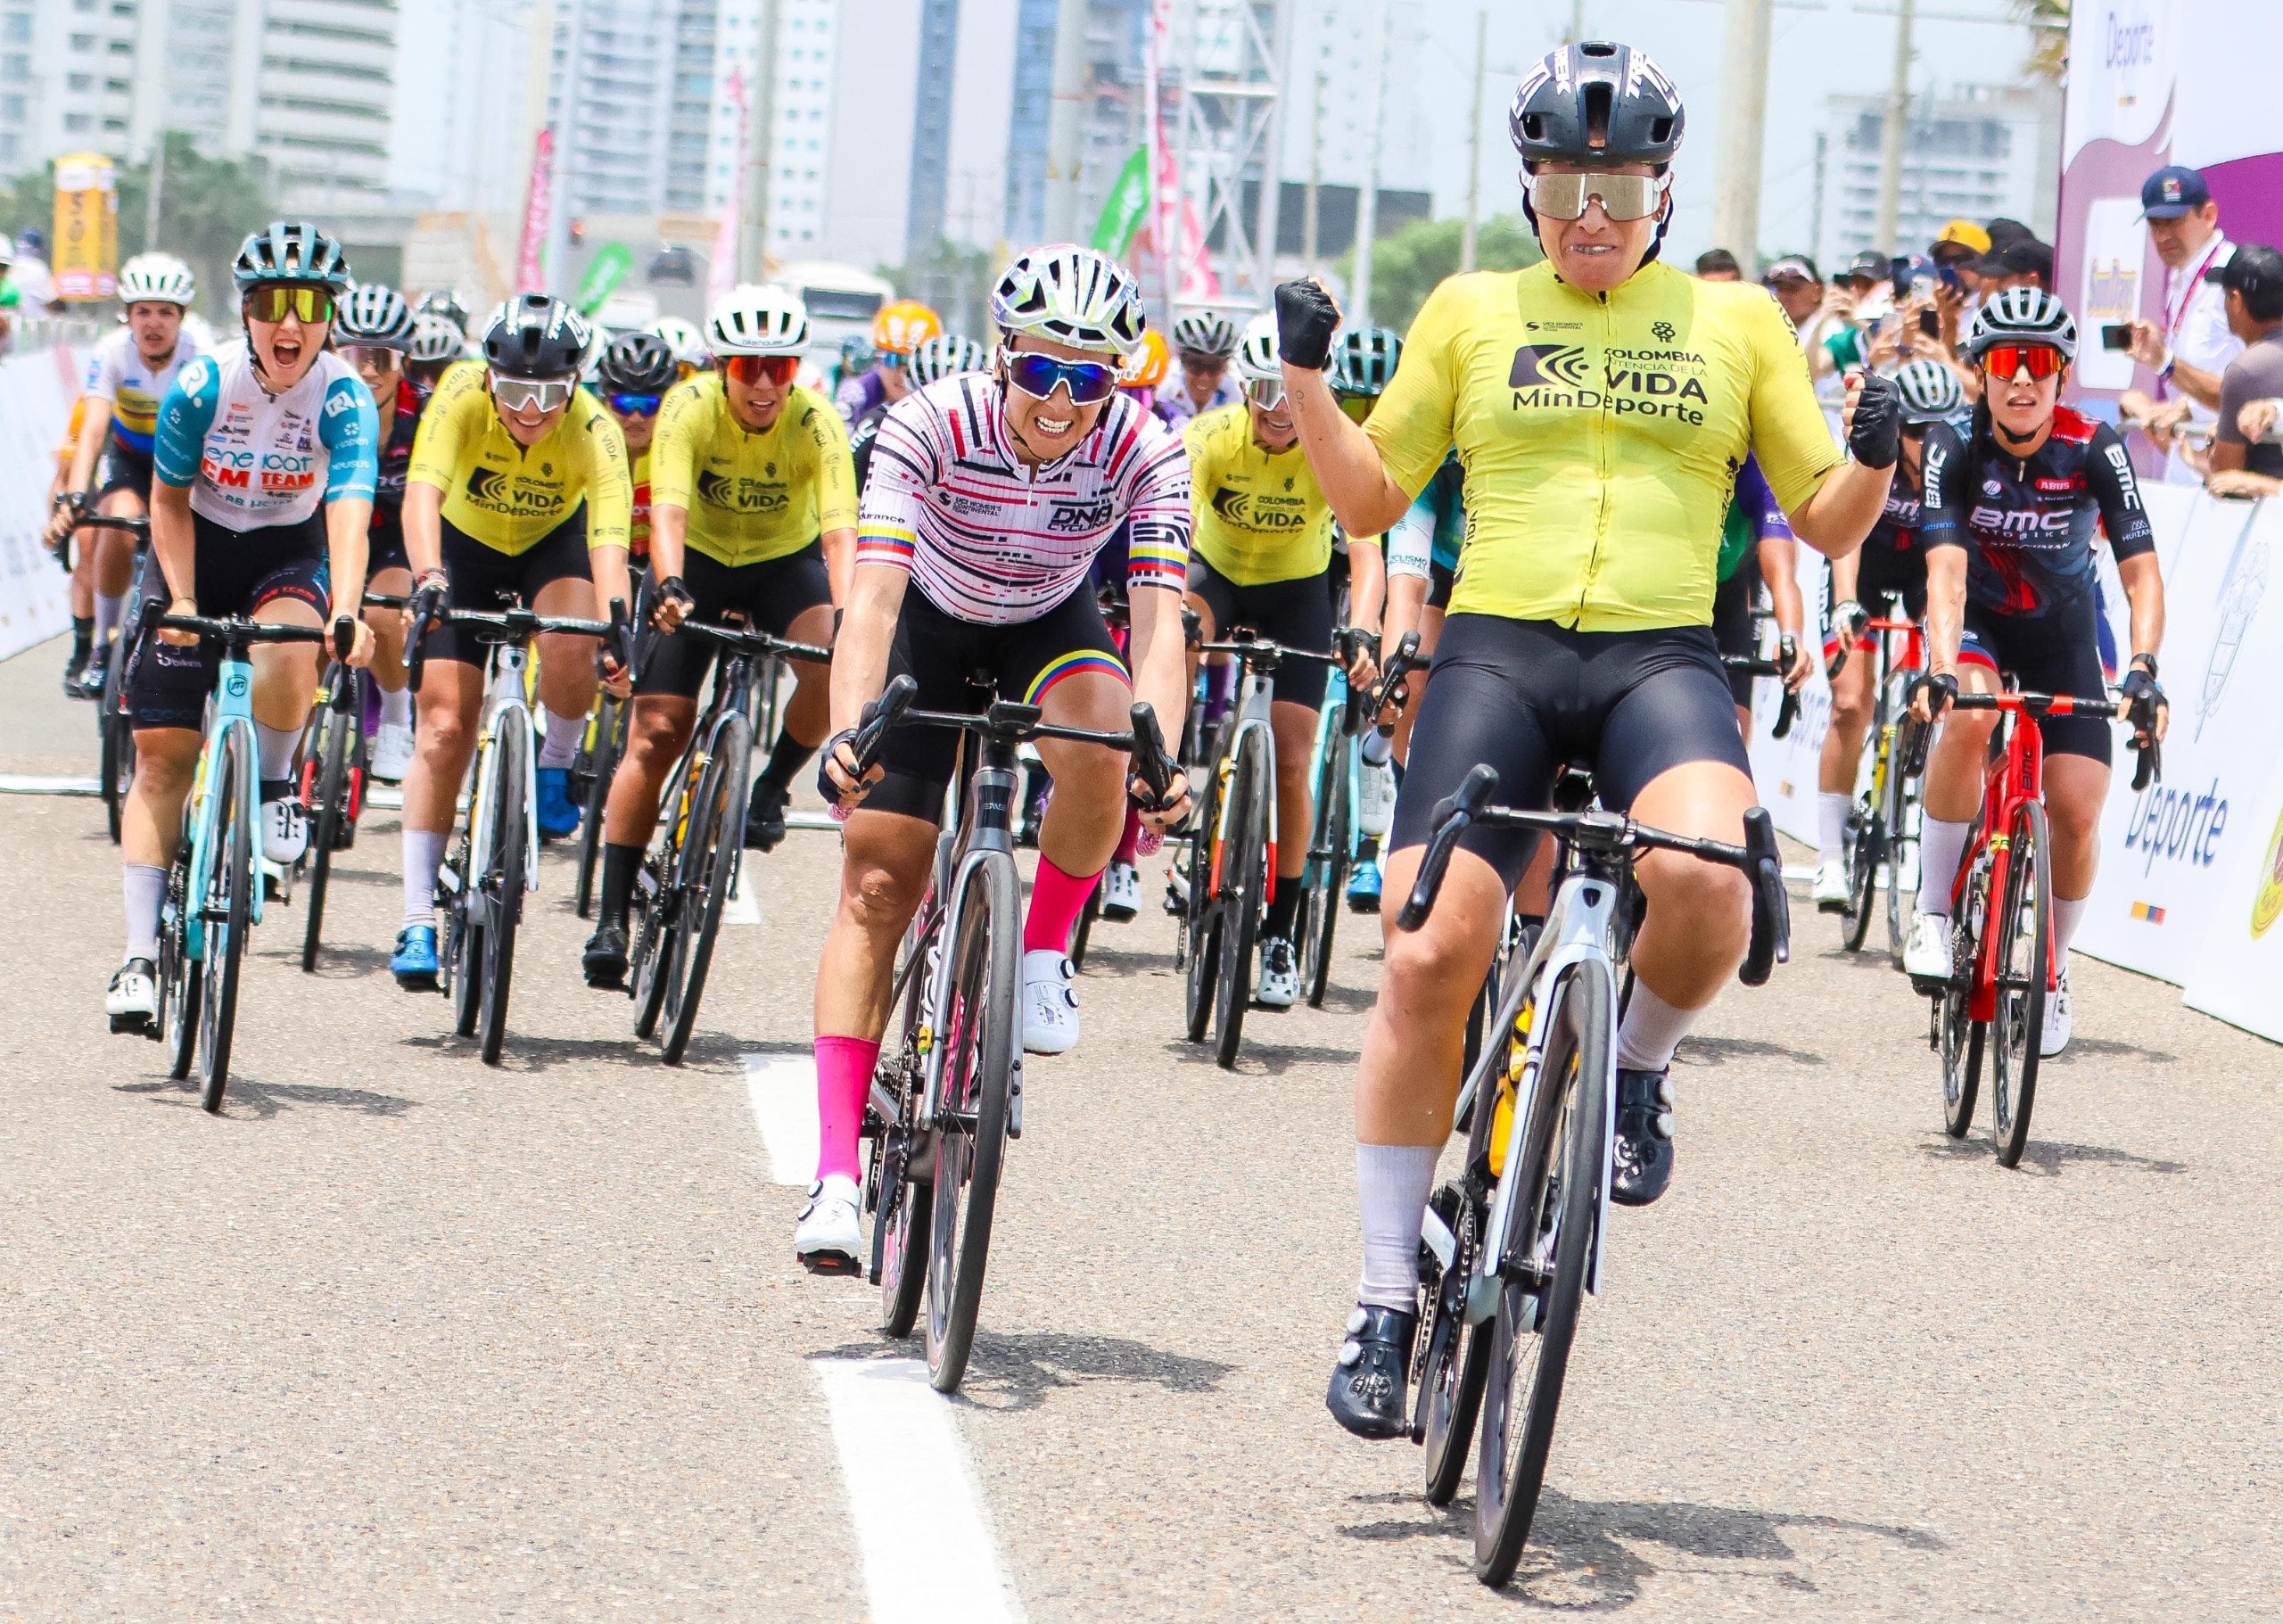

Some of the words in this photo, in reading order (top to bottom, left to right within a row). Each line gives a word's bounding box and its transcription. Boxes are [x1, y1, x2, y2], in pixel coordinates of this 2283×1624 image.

[1604, 348, 1706, 366] COLOMBIA
[1669, 364, 1689, 373] DE
[1692, 367, 1708, 377] LA
[1604, 365, 1709, 405] VIDA
[1512, 388, 1704, 426] MinDeporte
[201, 457, 251, 488] CM
[261, 472, 315, 488] TEAM
[1924, 441, 1947, 508] BMC
[2105, 443, 2140, 510] BMC
[2040, 482, 2070, 490] ABUS
[512, 489, 565, 508] VIDA
[738, 493, 790, 508] VIDA
[956, 497, 968, 505] UCI
[970, 501, 1002, 512] WOMEN'S
[1257, 495, 1306, 506] COLOMBIA
[952, 506, 969, 515] TEAM
[953, 501, 999, 516] CONTINENTAL
[1051, 502, 1113, 526] DNA
[859, 512, 905, 524] durance
[1254, 510, 1306, 527] VIDA
[1970, 506, 2073, 531] BMC
[2022, 743, 2034, 790] BMC
[2125, 777, 2229, 878] Deporte
